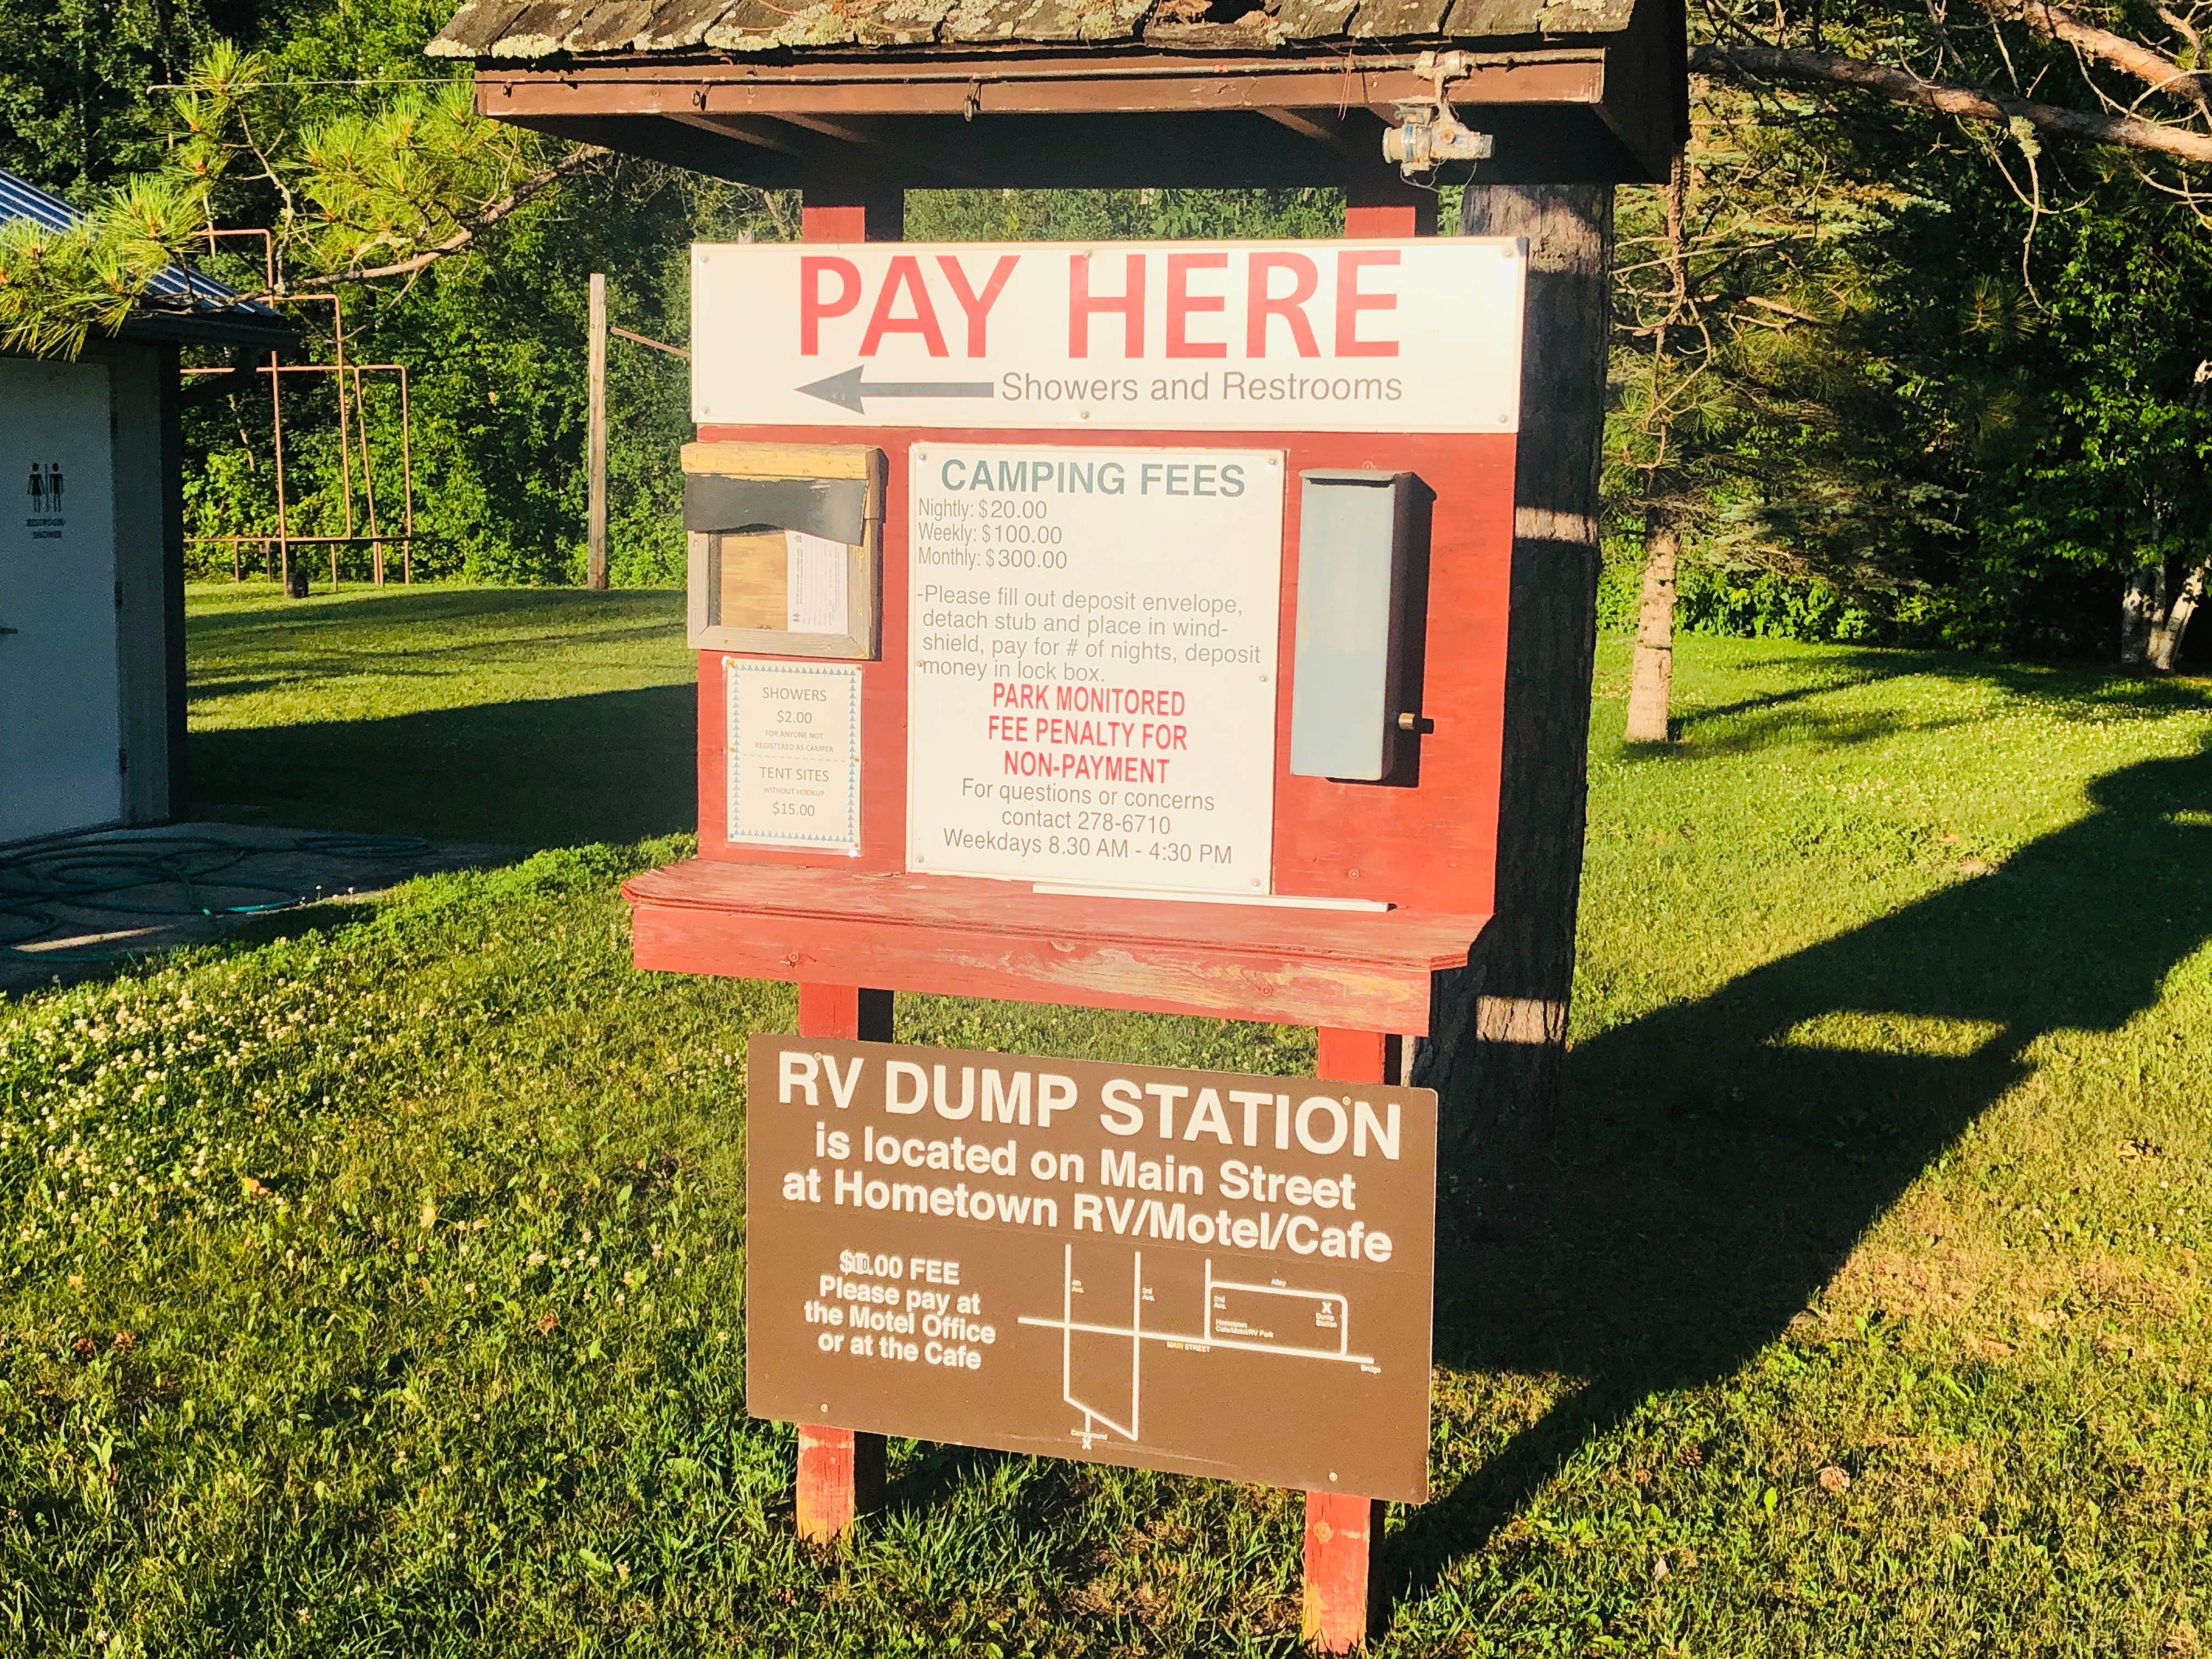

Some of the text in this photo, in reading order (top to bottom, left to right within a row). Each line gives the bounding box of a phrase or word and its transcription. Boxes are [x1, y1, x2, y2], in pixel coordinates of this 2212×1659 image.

[800, 251, 1400, 358] PAY HERE
[1002, 372, 1401, 400] Showers and Restrooms
[942, 459, 1244, 496] CAMPING FEES
[919, 498, 1046, 522] Nightly: $20.00
[919, 522, 1062, 546] Weekly: $100.00
[919, 546, 1066, 571] Monthly: $300.00
[998, 588, 1017, 606] fill
[1025, 590, 1055, 607] out
[1063, 590, 1135, 613] deposit
[1143, 594, 1241, 617] envelope,
[923, 609, 1227, 637] detach stub and place in wind-
[923, 633, 1260, 667] shield, pay for # of nights, deposit
[923, 659, 1104, 681] money in lock box.
[763, 687, 826, 701] SHOWERS
[994, 683, 1184, 716] PARK MONITORED
[777, 710, 811, 724] $2.00
[989, 715, 1186, 749] FEE PENALTY FOR
[759, 767, 828, 781] TENT SITES
[1005, 752, 1169, 782] NON-PAYMENT
[963, 778, 1214, 810] For questions or concerns
[774, 802, 814, 816] $15.00
[1002, 810, 1170, 834] contact 278-6710
[944, 828, 1041, 856] Weekdays
[1097, 839, 1127, 857] AM
[1149, 842, 1191, 861] 4:30
[1200, 844, 1231, 864] PM
[780, 1052, 1401, 1161] RV DUMP STATION
[817, 1122, 1356, 1210] is located on Main Street
[783, 1169, 1392, 1263] at Hometown RV/Motel/Cafe
[911, 1258, 959, 1285] FEE
[1271, 1278, 1286, 1287] Alley
[820, 1274, 980, 1316] Please pay at
[804, 1301, 996, 1344] the Motel Office
[1216, 1319, 1248, 1328] Hometown
[1316, 1312, 1334, 1321] Dump
[1259, 1330, 1273, 1338] Park
[819, 1333, 981, 1369] or at the Cafe
[1184, 1344, 1211, 1353] STREET
[1361, 1365, 1381, 1374] Bridge
